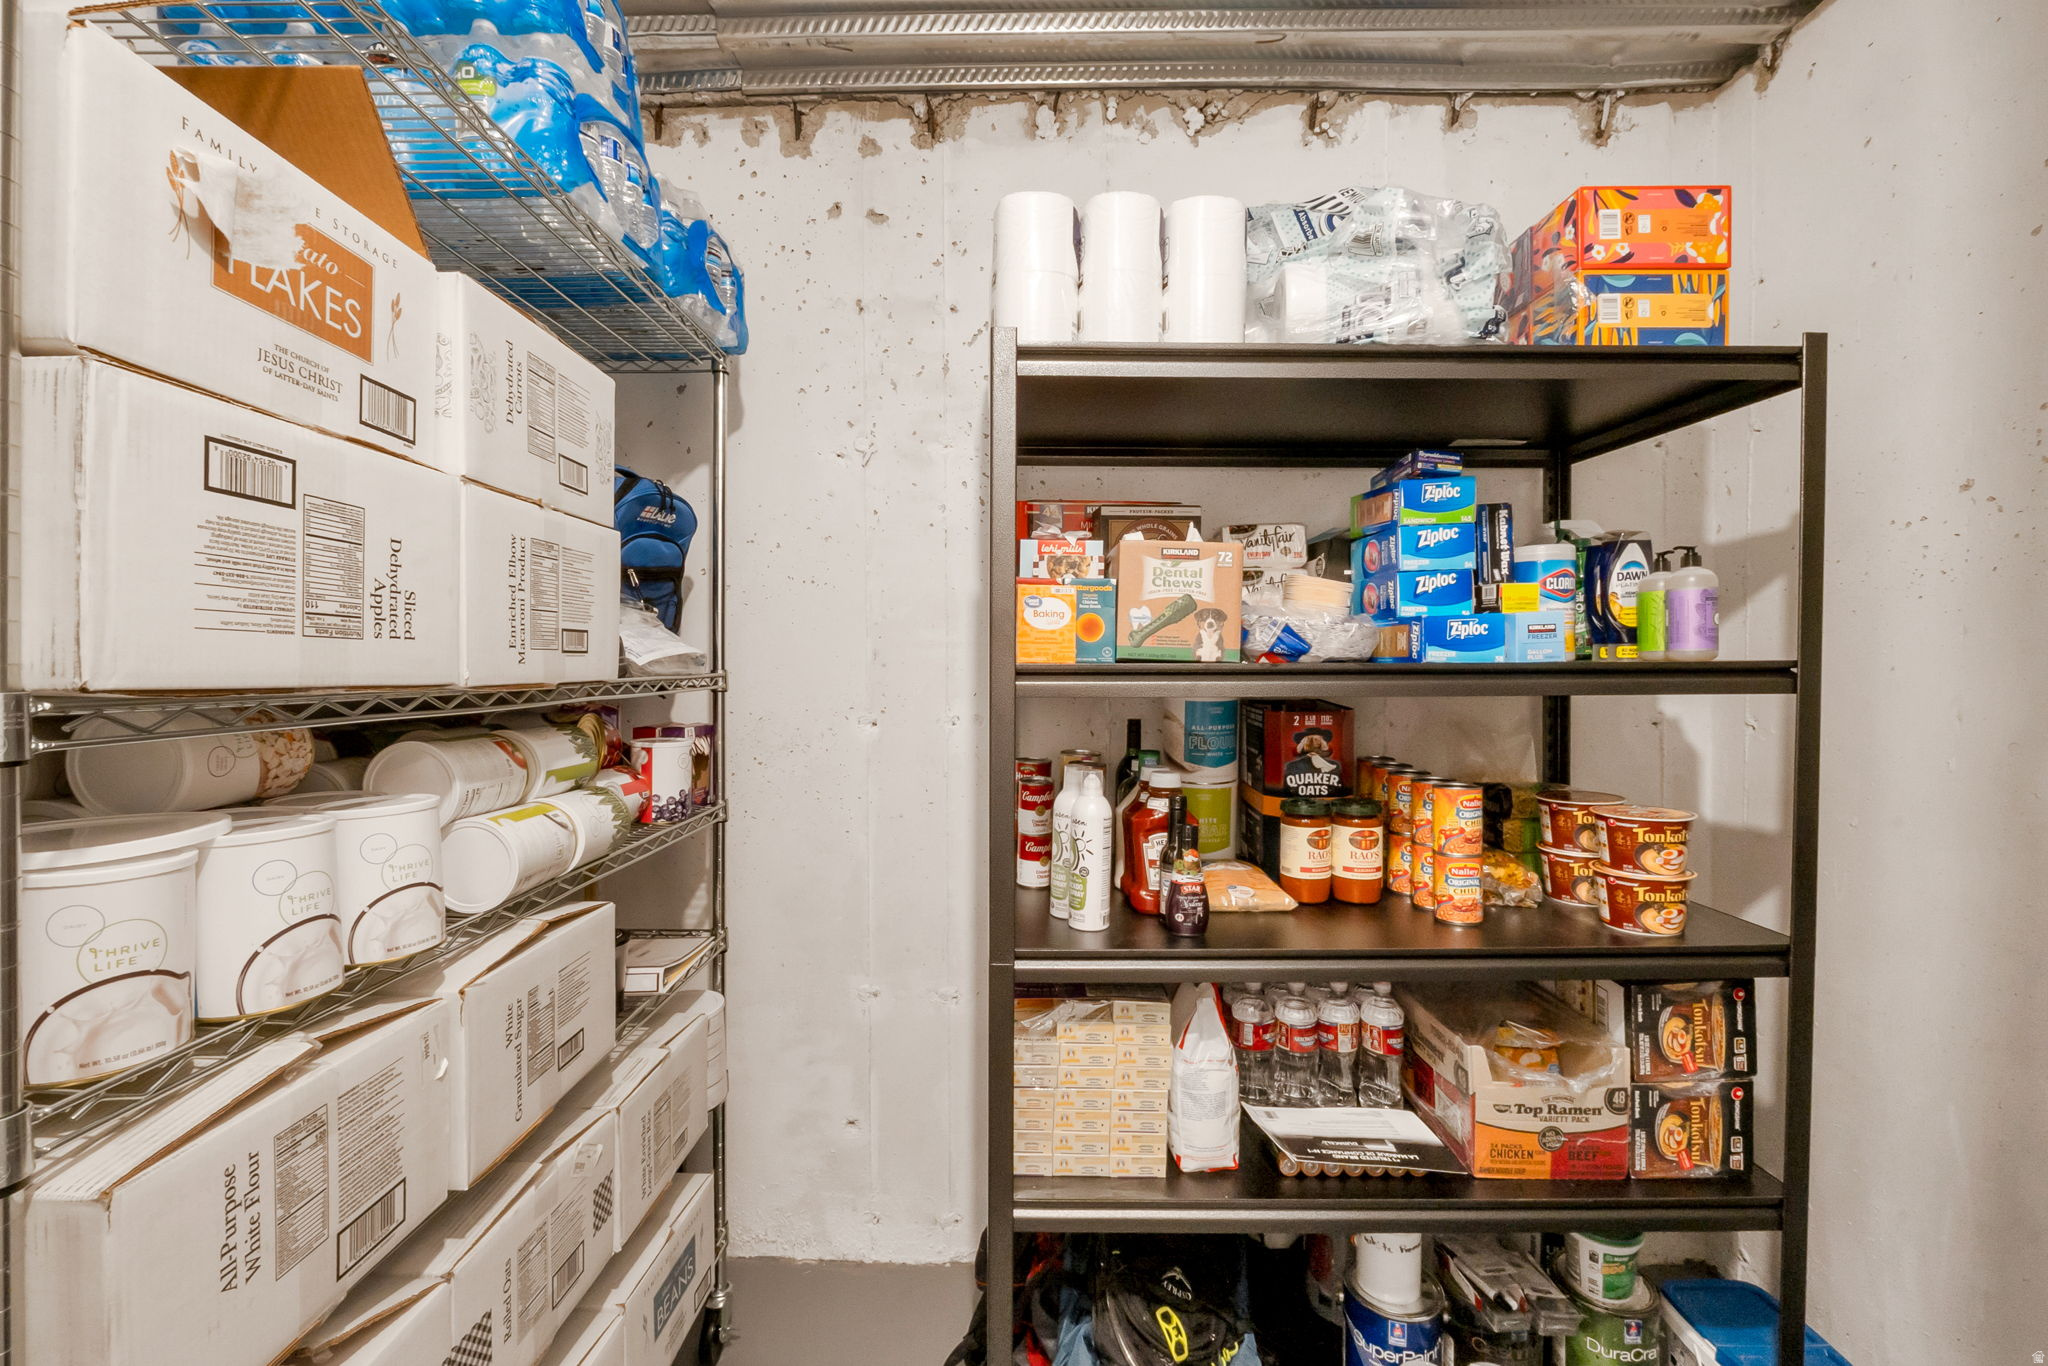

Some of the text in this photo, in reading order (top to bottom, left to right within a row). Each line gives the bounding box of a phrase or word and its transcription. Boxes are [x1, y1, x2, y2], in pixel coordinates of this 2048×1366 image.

[181, 115, 259, 174] FAMILY
[332, 218, 399, 270] STORAGE
[273, 343, 289, 356] THE
[290, 348, 322, 370] CHURCH
[257, 348, 344, 394] JESUS CHRIST
[505, 338, 515, 425] Dehydrated
[262, 366, 339, 403] OF LATTER-DAY SAINTS
[515, 361, 523, 415] Carrots
[1424, 485, 1461, 503] Ziploc
[1136, 523, 1179, 540] WHOLE GRAINS
[1416, 526, 1459, 548] Ziploc
[1499, 508, 1510, 575] Kabnet Wax
[1162, 548, 1199, 556] KIRKLAND
[1217, 551, 1233, 562] 72
[1389, 534, 1397, 565] Ziploc
[1151, 577, 1203, 589] Chews
[1152, 566, 1203, 579] Dental
[1415, 572, 1457, 595] Ziploc
[1545, 576, 1576, 590] CLORO
[1616, 571, 1648, 582] DAWN
[389, 537, 403, 640] Dehydrated
[508, 533, 518, 649] Enriched Elbow
[1387, 580, 1395, 610] Ziploc
[305, 600, 362, 611] Calories 110
[370, 577, 387, 640] Apples
[517, 536, 527, 665] Macaroni Product
[403, 589, 416, 641] Sliced
[1032, 609, 1065, 620] Baking
[314, 628, 362, 638] Nutrition Facts
[1449, 621, 1489, 640] Ziploc
[1411, 624, 1420, 660] Ziploc
[1293, 715, 1300, 726] 2
[1286, 772, 1339, 788] QUAKER
[1298, 785, 1329, 796] OATS
[1022, 790, 1054, 804] Campb
[1459, 811, 1482, 819] ORIGIN
[1025, 841, 1051, 854] Camp
[1349, 851, 1380, 860] RAO'S
[387, 857, 431, 874] THRIVE
[391, 869, 419, 883] LIFE
[1450, 867, 1480, 877] Nalley
[286, 886, 333, 906] THRIVE
[290, 901, 321, 917] LIFE
[88, 937, 161, 961] THRIVE
[93, 954, 138, 973] LIFE
[505, 1002, 514, 1050] White
[1692, 998, 1709, 1064] Tonkotsu
[514, 998, 525, 1122] Granulated Sugar
[1613, 1090, 1626, 1104] 48
[1514, 1103, 1602, 1118] Top Ramen
[1689, 1097, 1706, 1161] Tonkotsu
[1489, 1148, 1534, 1160] CHICKEN
[1568, 1151, 1599, 1161] BEEF
[220, 1163, 243, 1293] All-Purpose
[243, 1151, 261, 1285] White Flour
[656, 1256, 695, 1332] BEANS
[1161, 1278, 1193, 1301] OSPREY
[503, 1257, 513, 1345] Rolled Oats
[1353, 1328, 1442, 1365] SuperPaint
[1585, 1335, 1657, 1362] DuraCra
